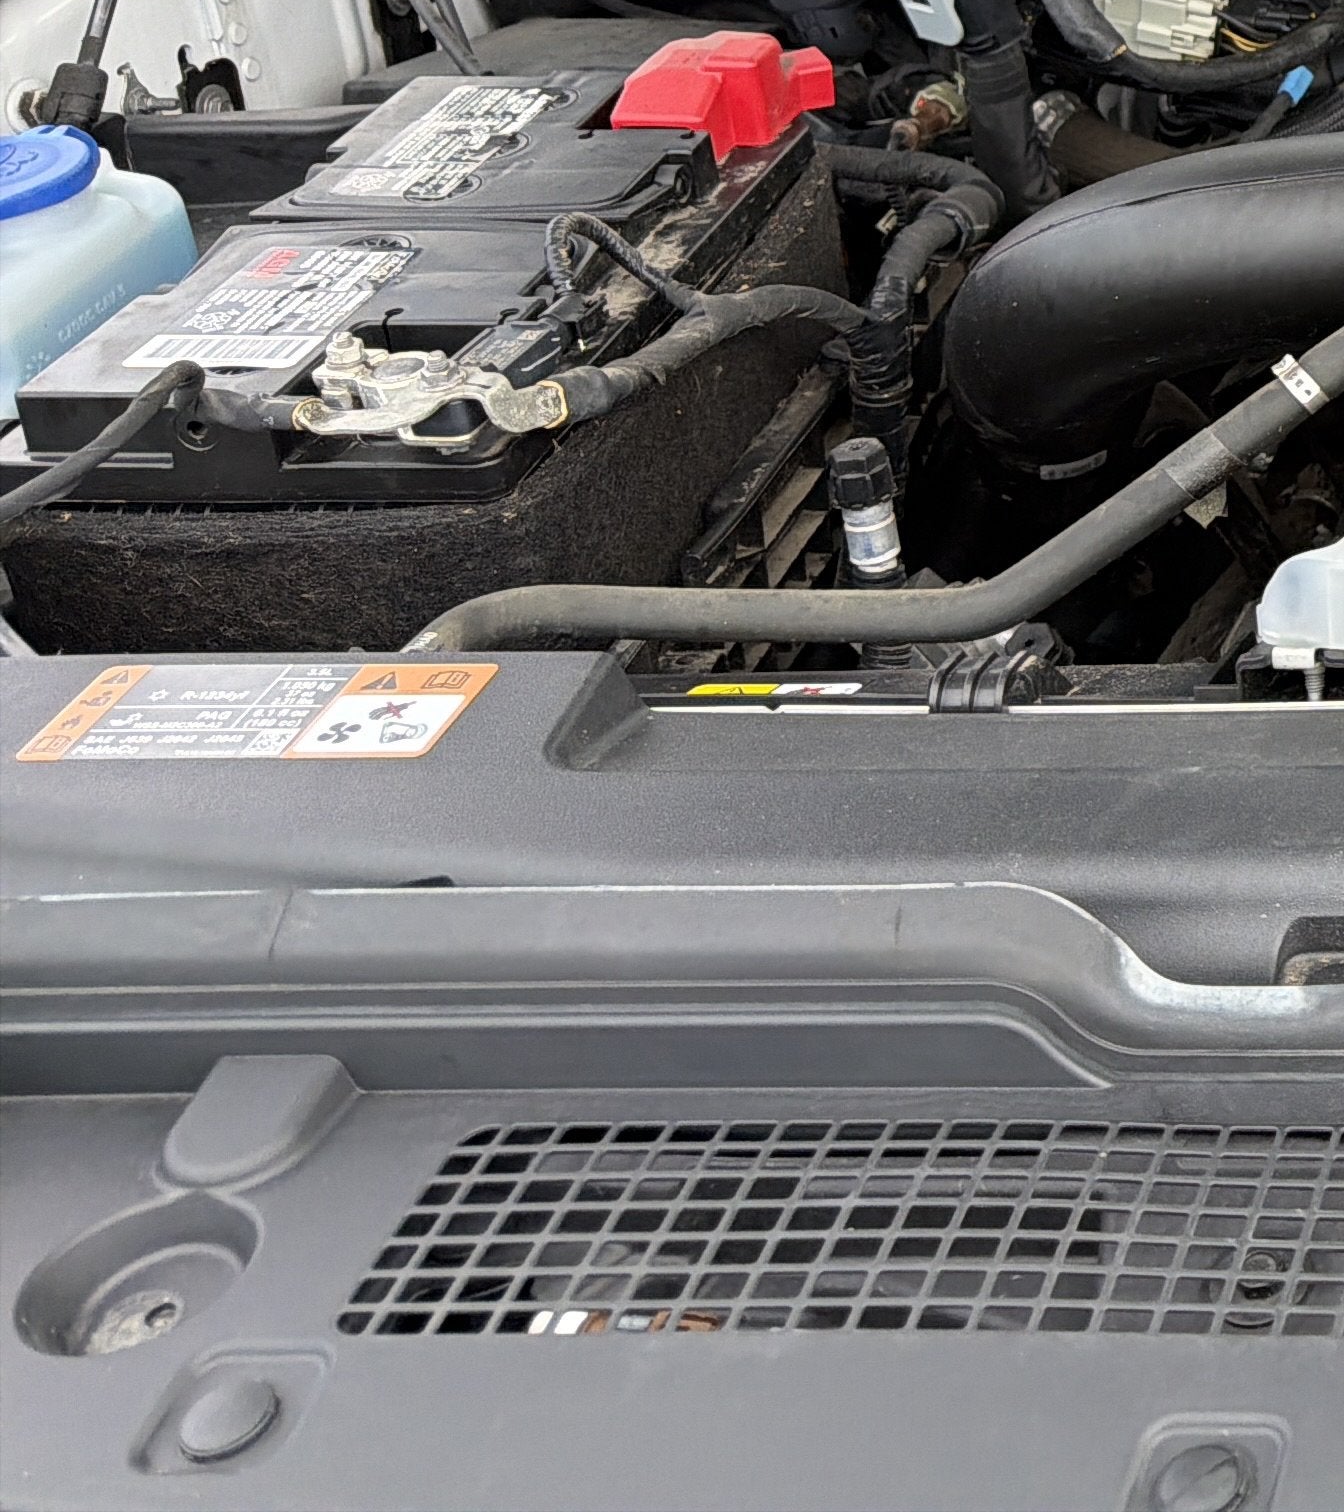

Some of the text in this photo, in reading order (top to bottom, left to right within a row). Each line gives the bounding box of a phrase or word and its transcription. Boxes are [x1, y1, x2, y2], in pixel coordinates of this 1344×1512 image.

[316, 680, 336, 692] kg
[179, 690, 250, 702] R-1234yf
[195, 710, 233, 721] PAG
[290, 709, 310, 717] oz
[277, 718, 303, 728] cc)
[83, 734, 116, 744] SAE
[70, 744, 140, 757] FoMoCo
